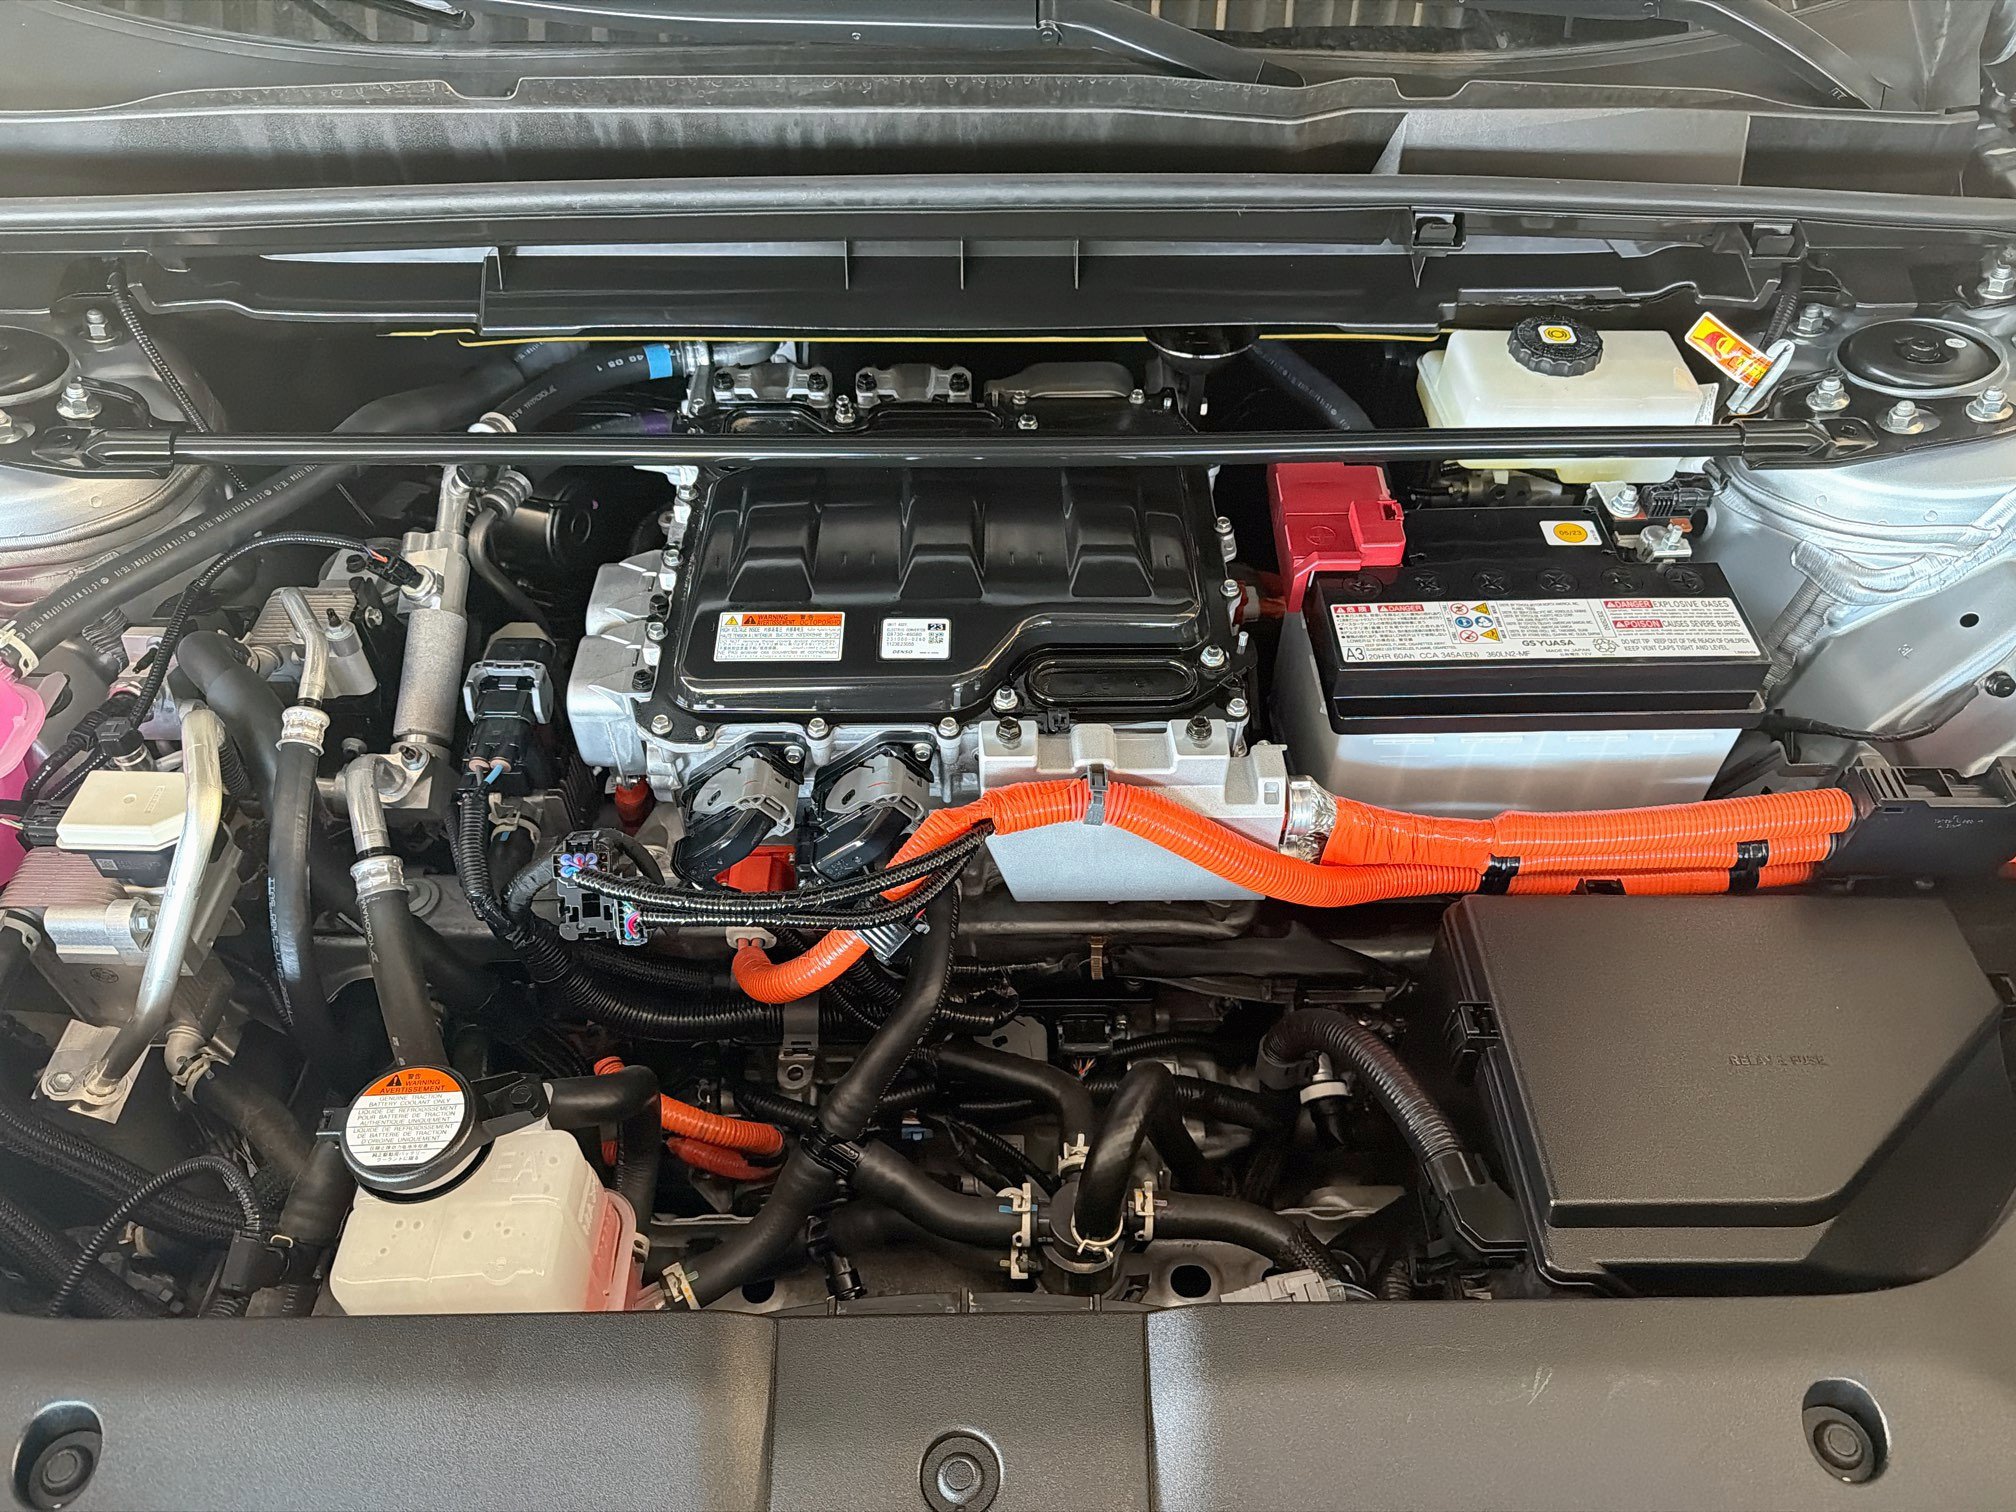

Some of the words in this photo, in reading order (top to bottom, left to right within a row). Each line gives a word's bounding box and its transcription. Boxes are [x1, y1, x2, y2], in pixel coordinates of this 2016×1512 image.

[1389, 604, 1423, 612] DANGER
[1614, 600, 1652, 608] DANGER
[1653, 600, 1699, 608] EXPLOSIVE
[1700, 600, 1730, 608] GASES
[1624, 620, 1661, 628] POISON
[1662, 620, 1689, 628] CAUSES
[1690, 620, 1716, 628] SEVERE
[1717, 620, 1740, 628] BURNS
[1539, 639, 1576, 647] YUASA
[1346, 647, 1365, 661] A3
[1393, 652, 1415, 660] 60Ah
[1440, 651, 1480, 659] 345A(EN)
[1486, 650, 1530, 658] 360LN2-MF
[380, 1085, 445, 1094] AVERTISSEMENT
[398, 1105, 457, 1113] REFROIDISSEMENT
[393, 1123, 454, 1132] REFROIDISSEMENT
